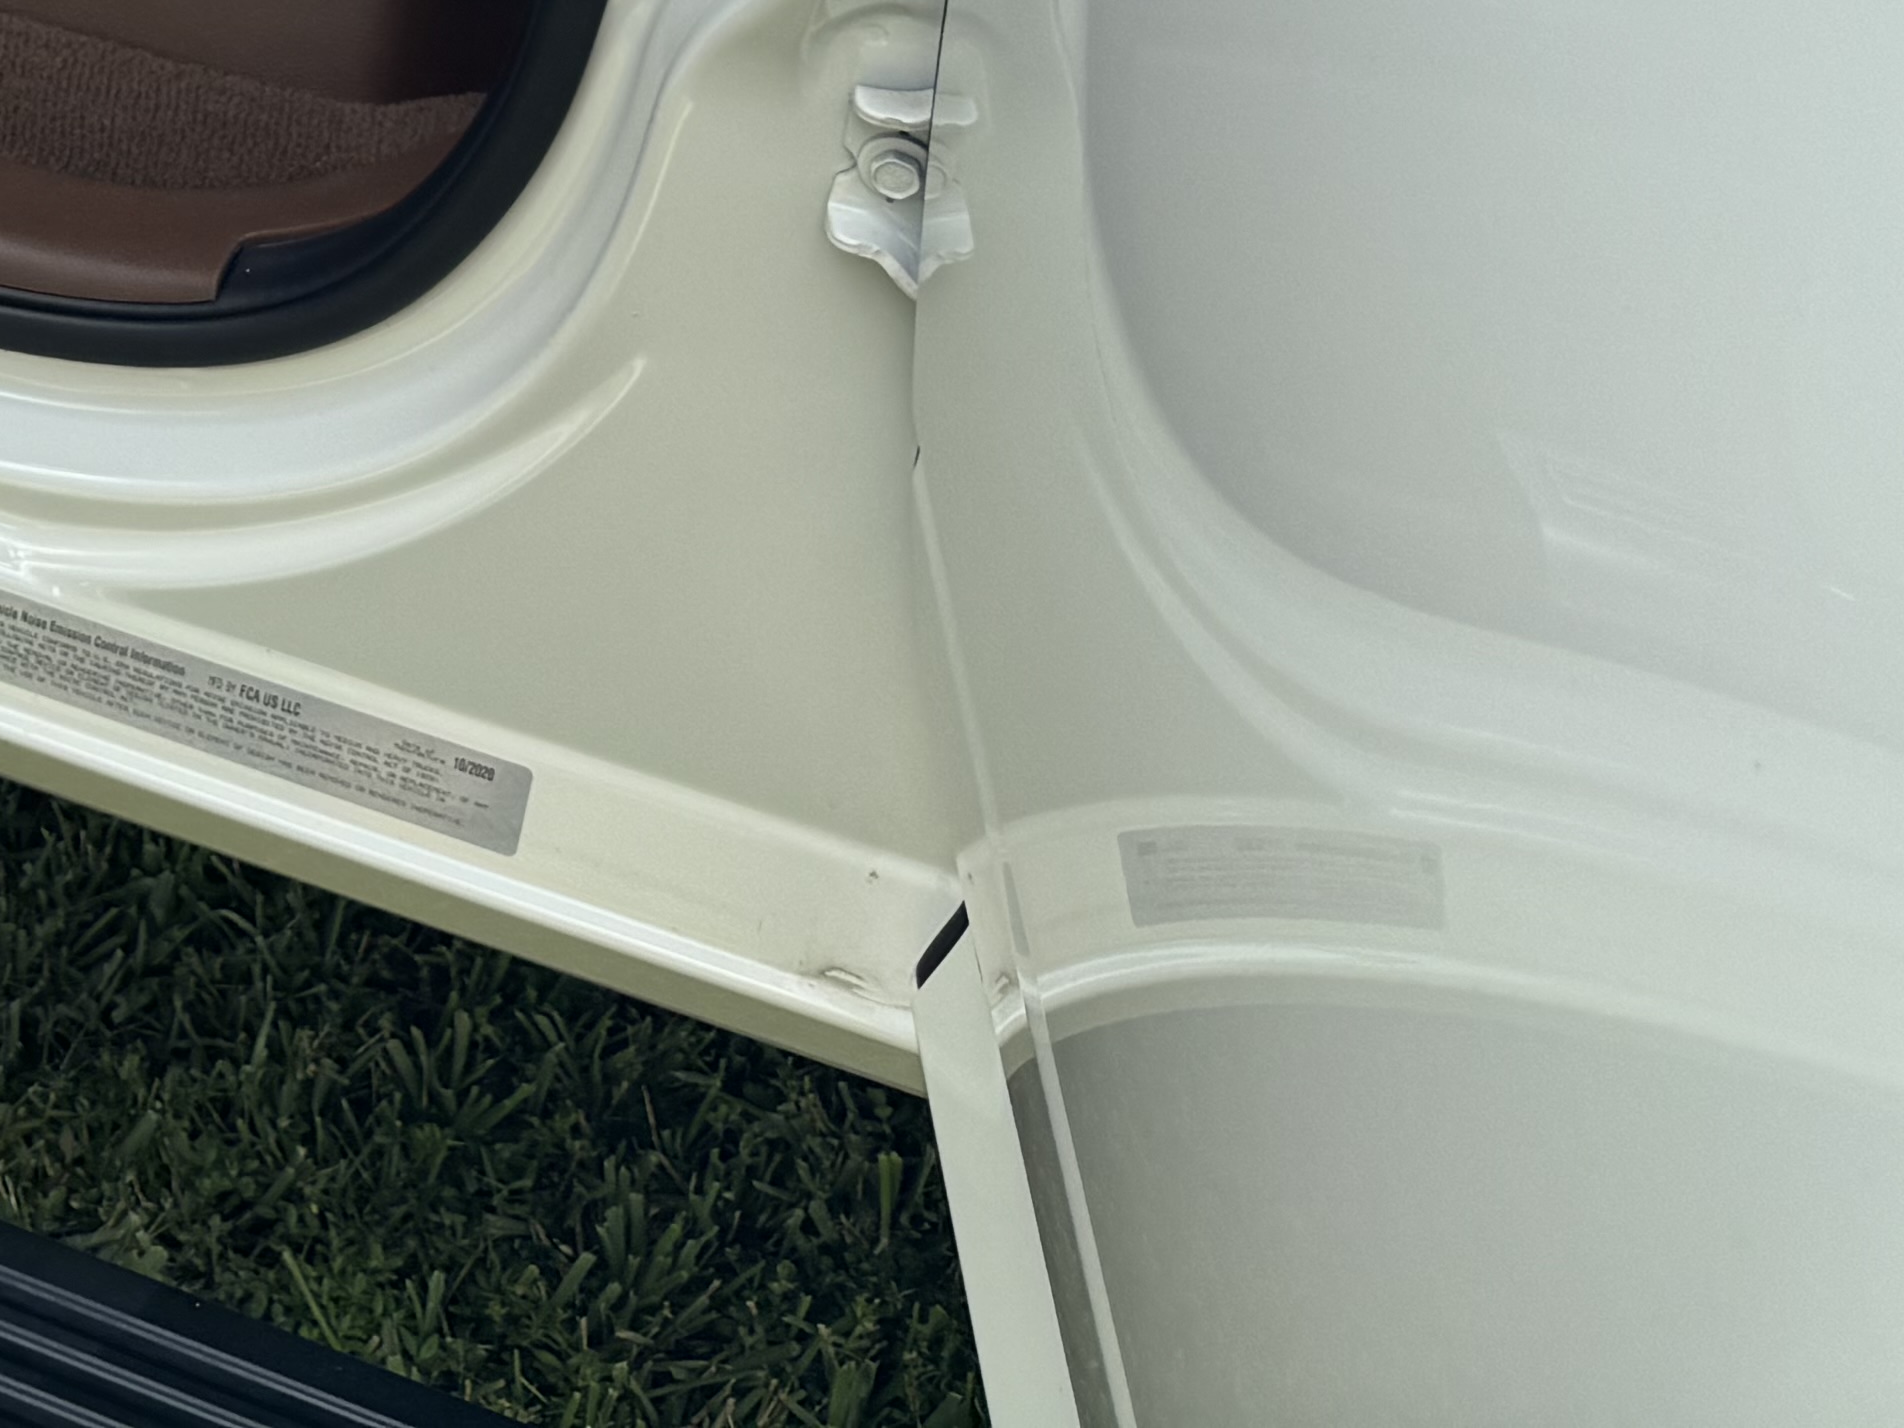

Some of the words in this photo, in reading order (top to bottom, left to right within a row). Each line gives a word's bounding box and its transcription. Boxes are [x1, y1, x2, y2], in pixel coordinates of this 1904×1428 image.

[19, 609, 47, 629] Noise
[49, 619, 91, 644] Emission
[93, 635, 129, 657] Control
[130, 647, 185, 676] Information
[238, 684, 260, 703] FCA
[262, 692, 278, 709] US
[280, 698, 301, 717] LLC
[452, 755, 495, 781] 10/2020
